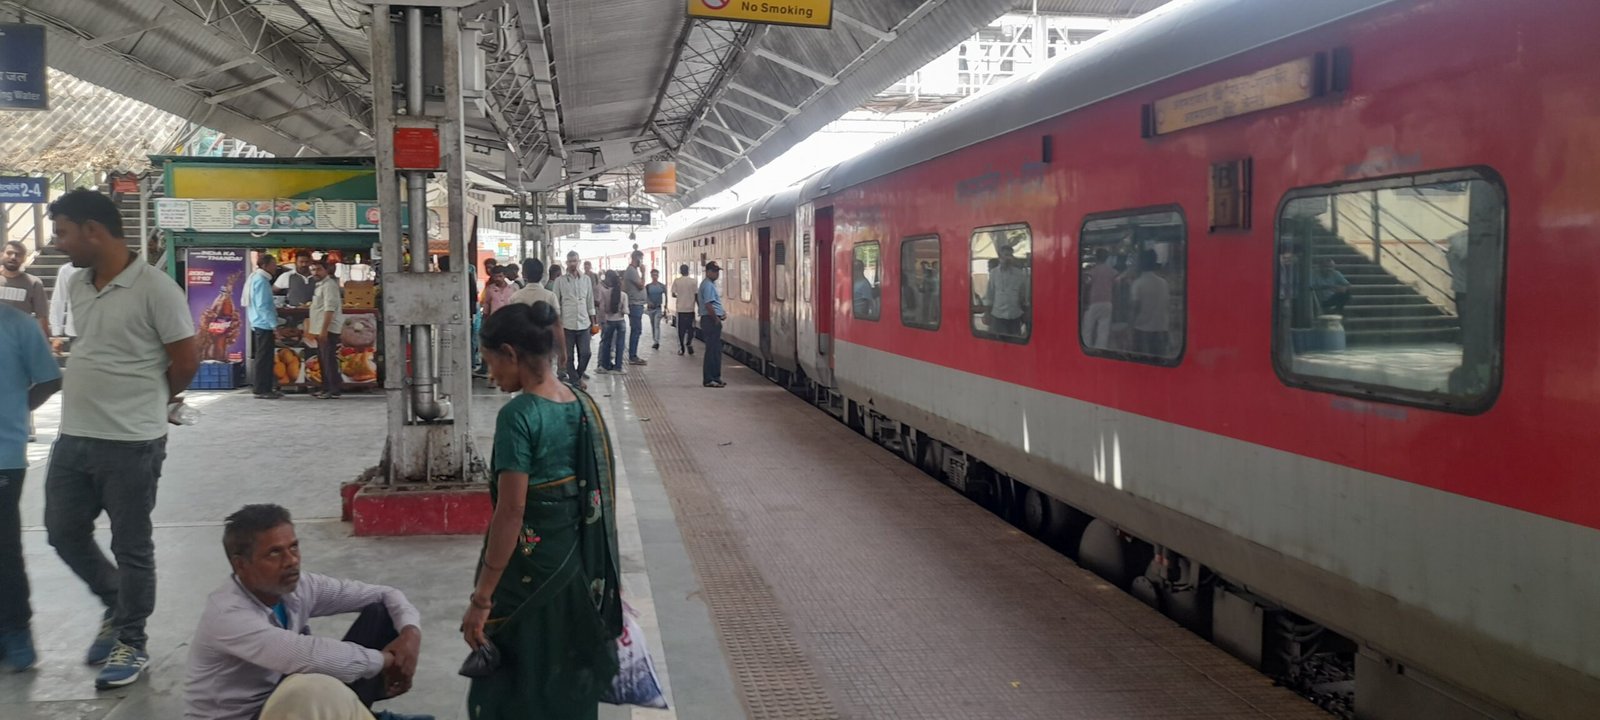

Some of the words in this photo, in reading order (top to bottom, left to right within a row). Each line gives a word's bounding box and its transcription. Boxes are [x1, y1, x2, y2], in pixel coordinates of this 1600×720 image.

[741, 2, 758, 12] No
[761, 3, 813, 18] Smoking
[14, 90, 41, 100] Water
[20, 183, 42, 197] 2-4
